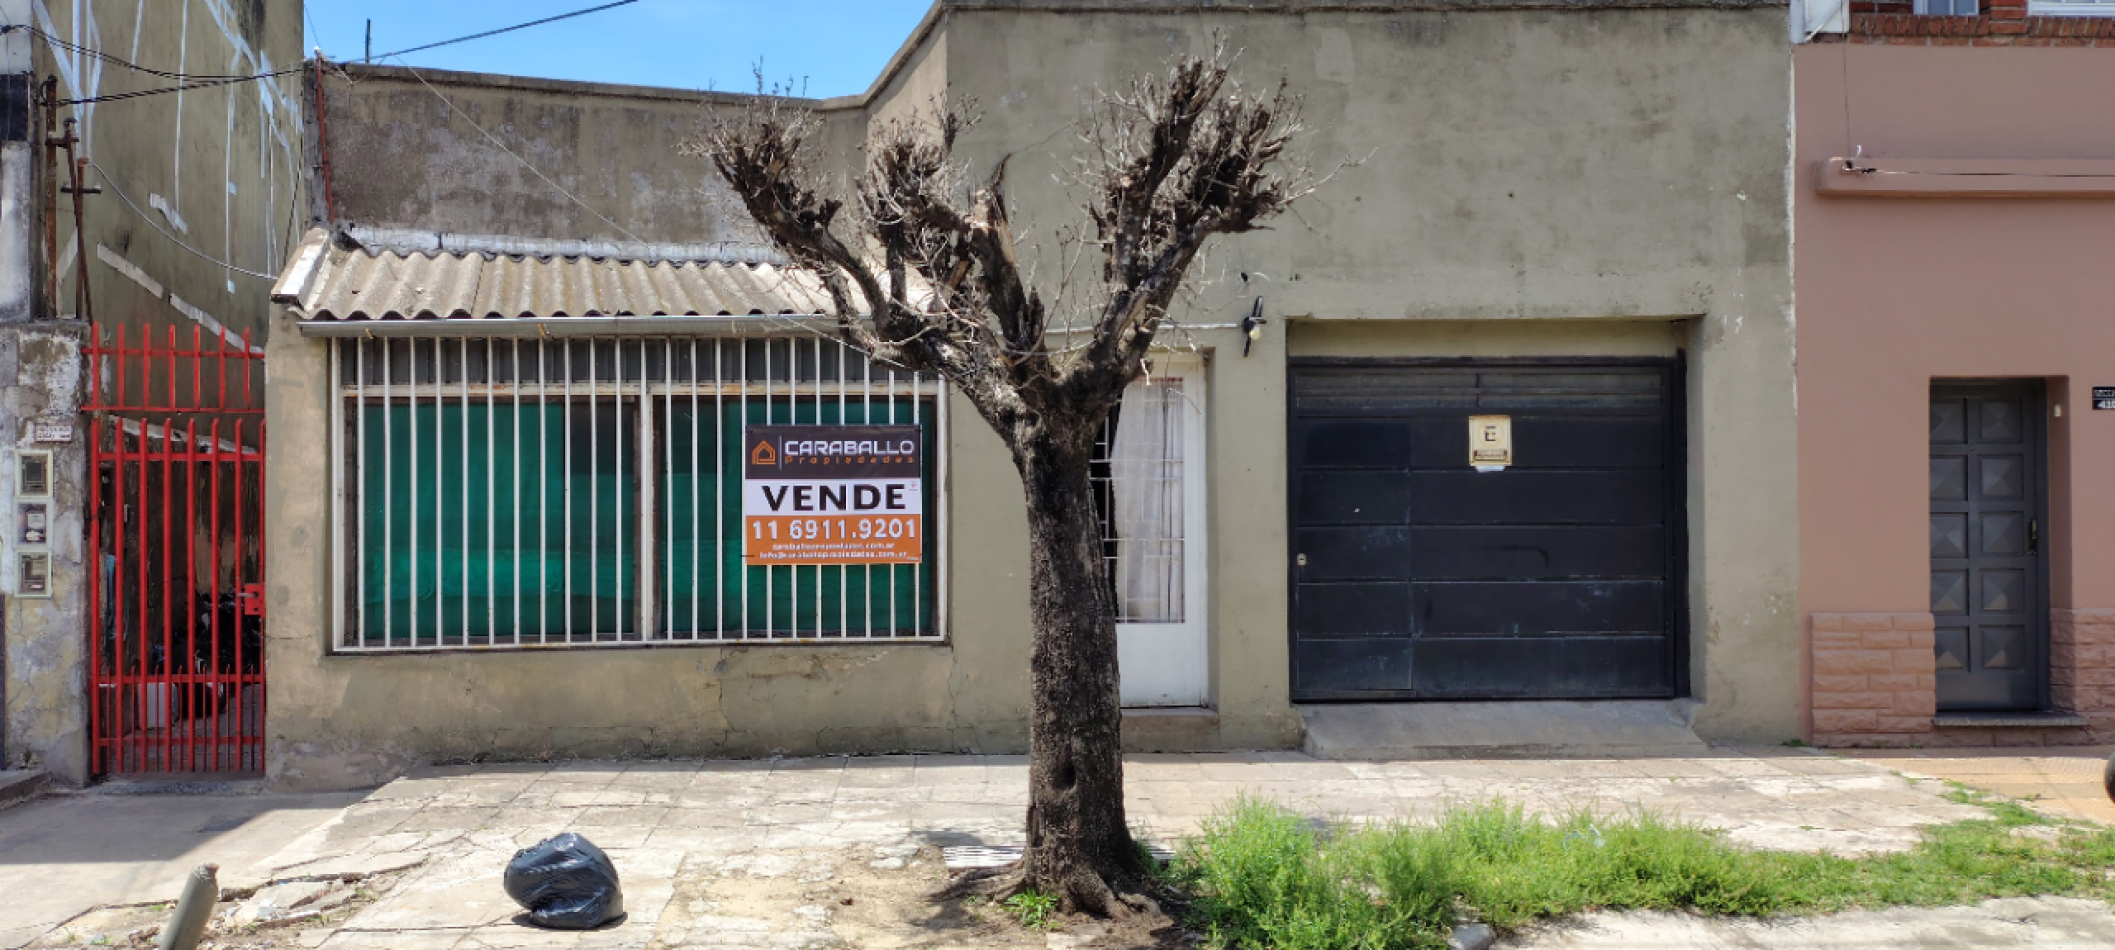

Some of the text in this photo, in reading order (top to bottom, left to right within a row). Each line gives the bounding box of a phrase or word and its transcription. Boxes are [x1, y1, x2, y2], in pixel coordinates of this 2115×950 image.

[1485, 425, 1496, 441] E
[784, 440, 915, 455] CARABALLO
[784, 455, 915, 465] Propiedades
[761, 484, 906, 511] VENDE
[752, 518, 916, 540] 11 6911.9201
